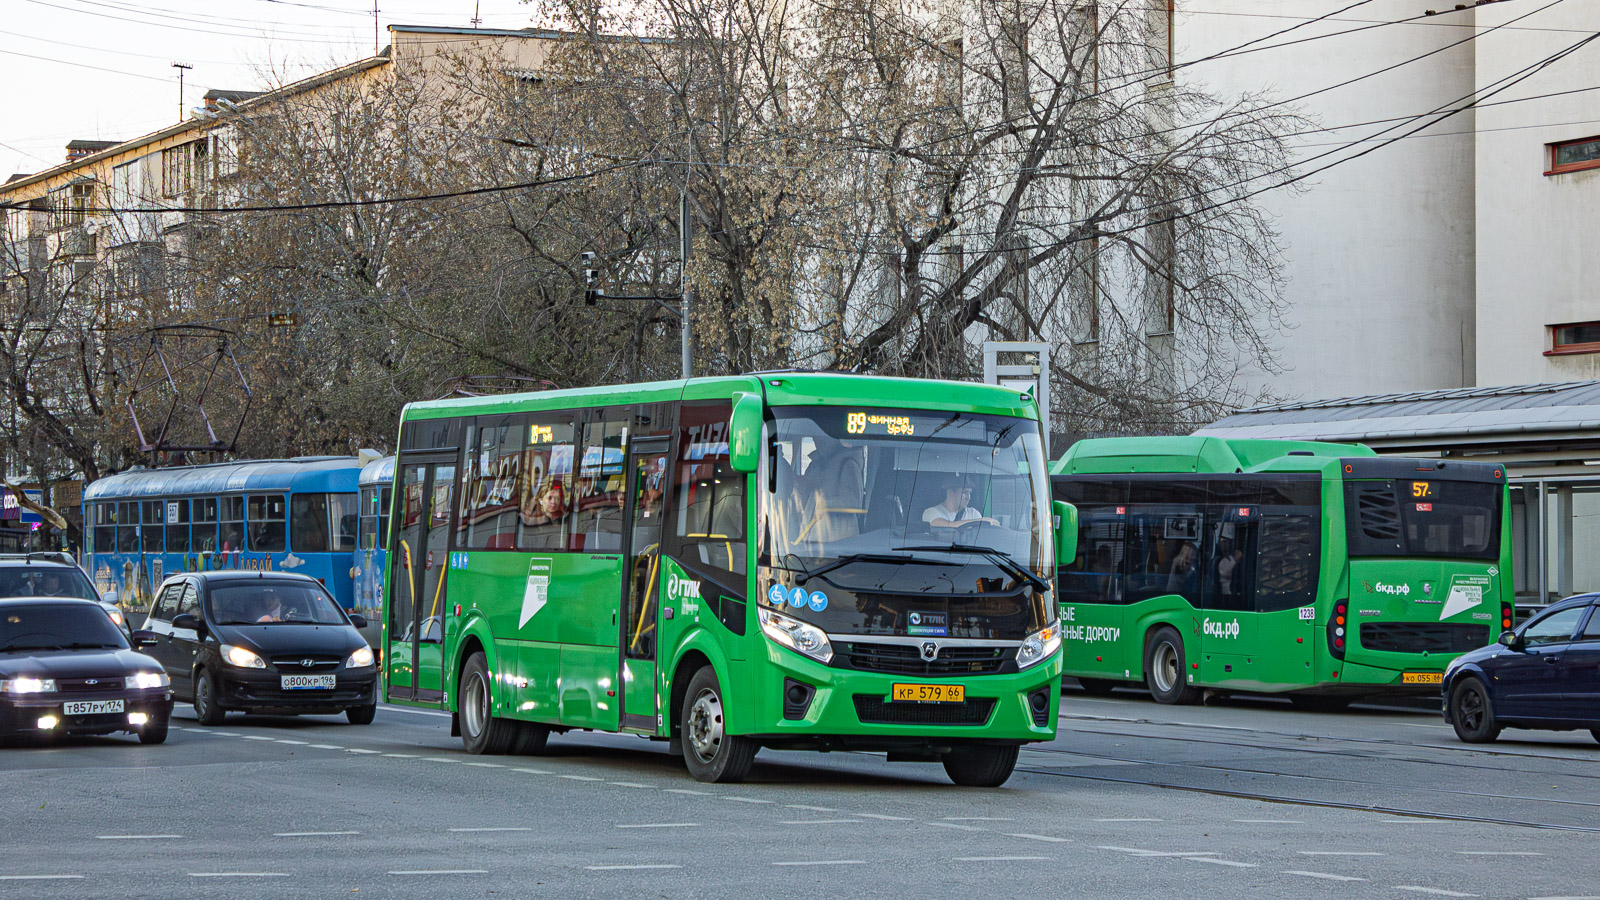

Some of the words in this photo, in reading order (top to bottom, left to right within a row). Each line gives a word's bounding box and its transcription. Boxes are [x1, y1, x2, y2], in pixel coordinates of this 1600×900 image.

[847, 412, 866, 434] 89
[678, 579, 701, 598] ГТЛК
[1375, 582, 1410, 596] бкд.рф
[922, 615, 945, 624] ГТЛК
[1300, 609, 1314, 619] 1238
[1085, 626, 1120, 643] ДОРОГИ
[1203, 617, 1240, 640] бкд.рф
[1417, 674, 1431, 683] 055
[899, 688, 914, 699] КР
[919, 687, 942, 700] 579
[947, 687, 960, 697] 66
[66, 702, 105, 714] Т857РУ
[107, 701, 122, 710] 174
